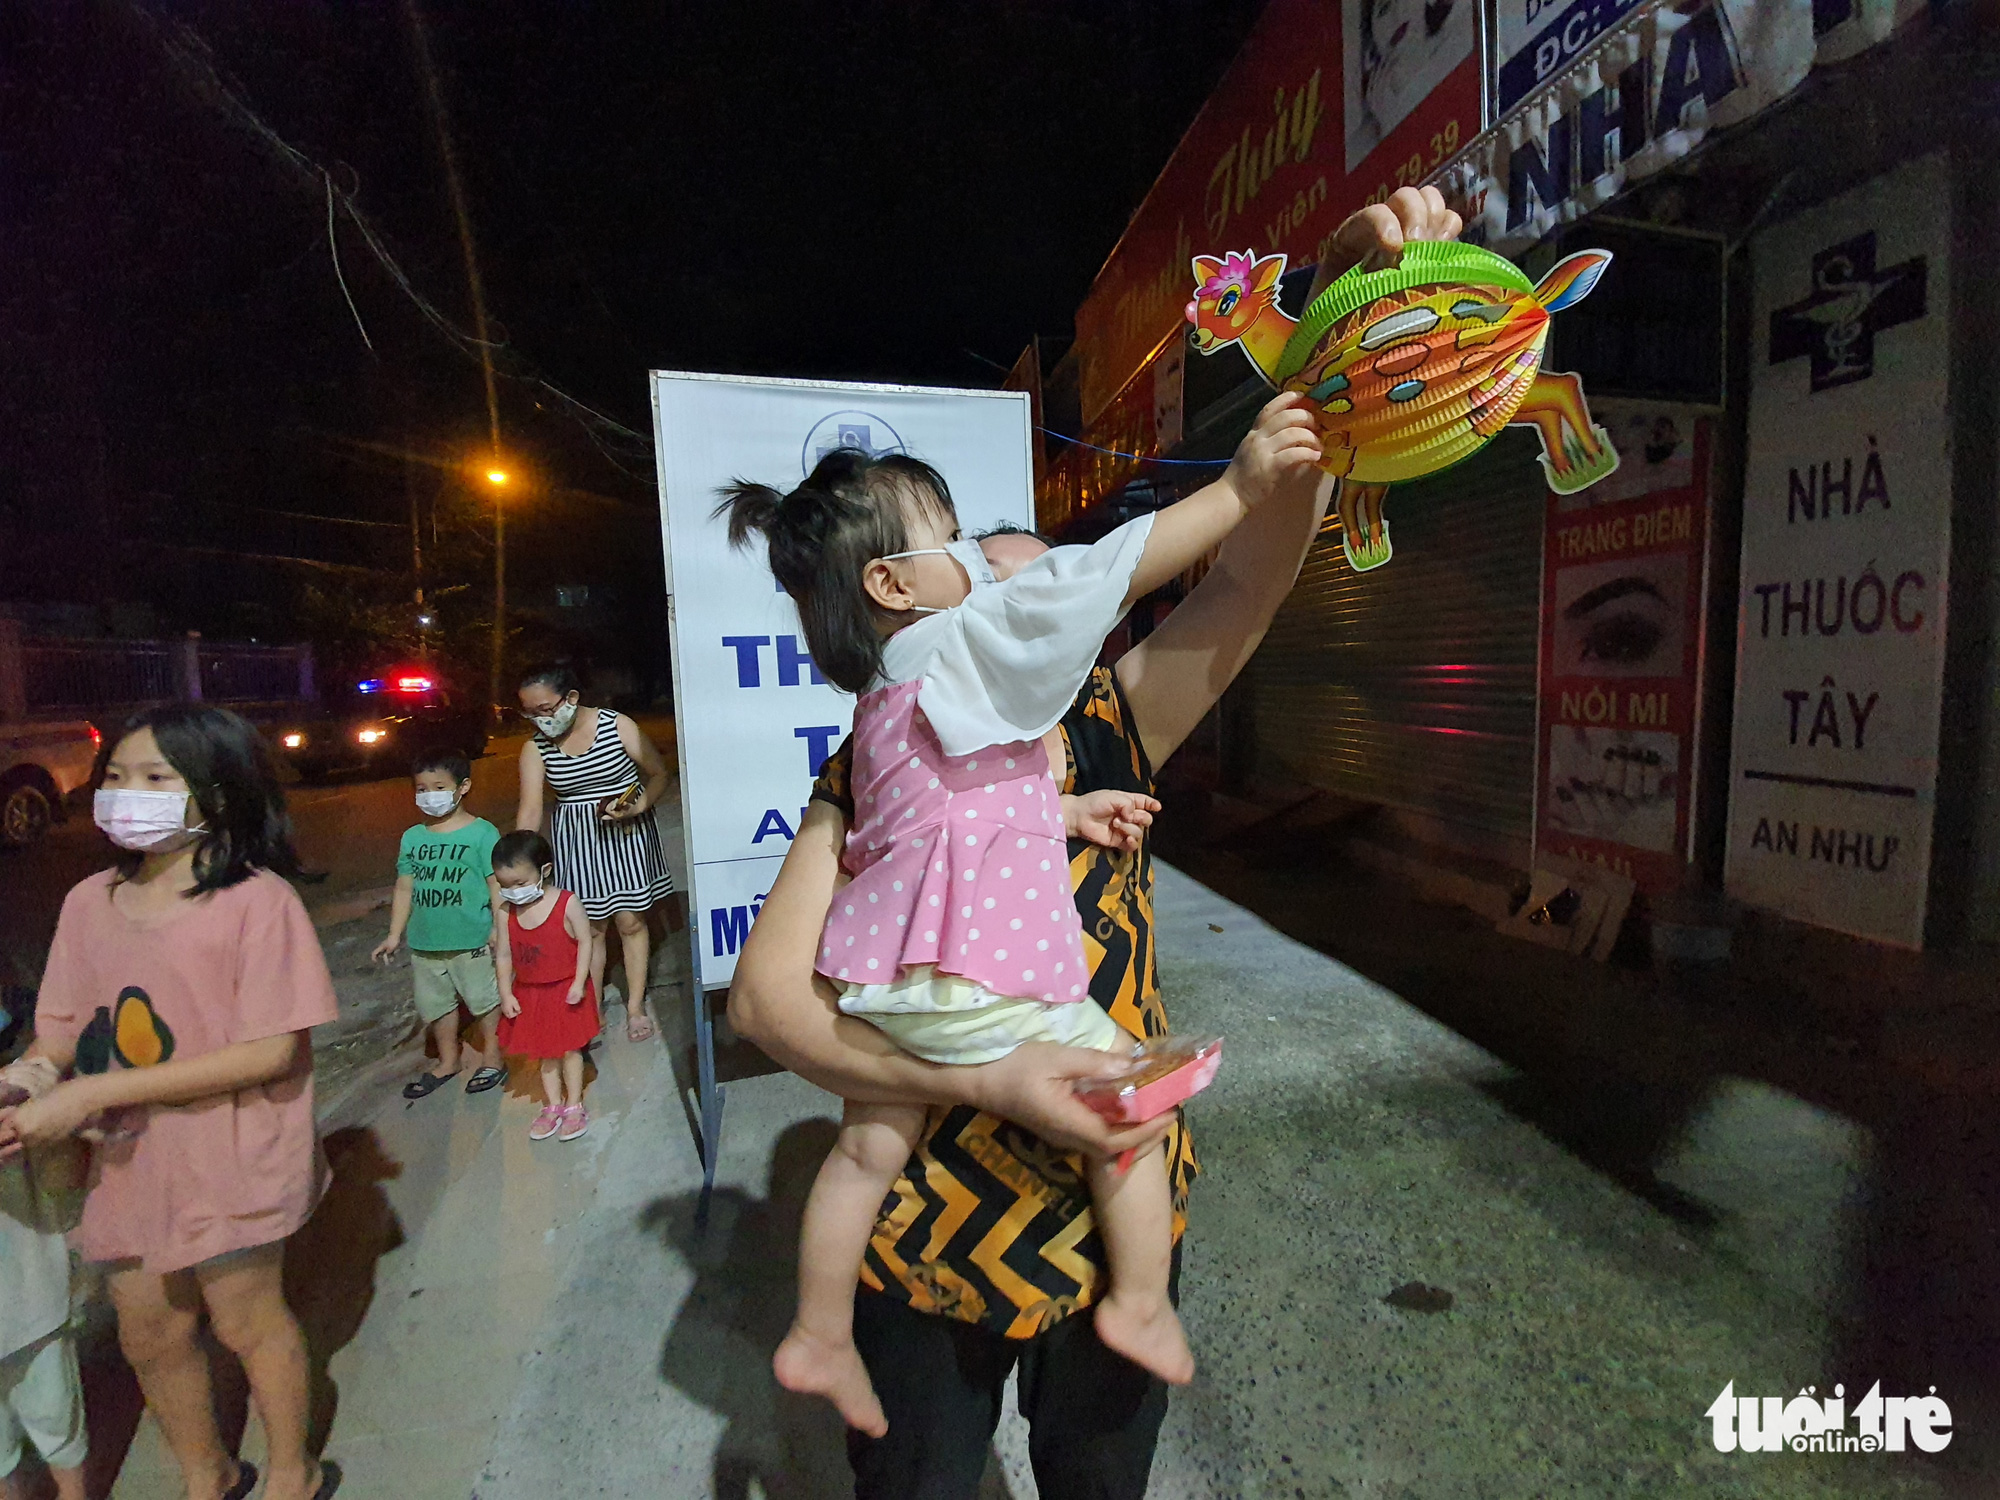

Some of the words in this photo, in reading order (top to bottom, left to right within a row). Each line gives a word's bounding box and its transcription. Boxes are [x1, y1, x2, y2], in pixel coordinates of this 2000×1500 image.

[1788, 435, 1892, 524] NHÀ
[1556, 517, 1627, 558] TRANG
[1754, 558, 1926, 638] THUỐC
[1628, 692, 1669, 726] MI
[1782, 675, 1881, 749] TÂY
[418, 844, 449, 861] GET
[450, 844, 471, 860] IT
[1752, 817, 1800, 855] AN
[1810, 825, 1900, 873] NHƯ
[441, 866, 469, 884] MY
